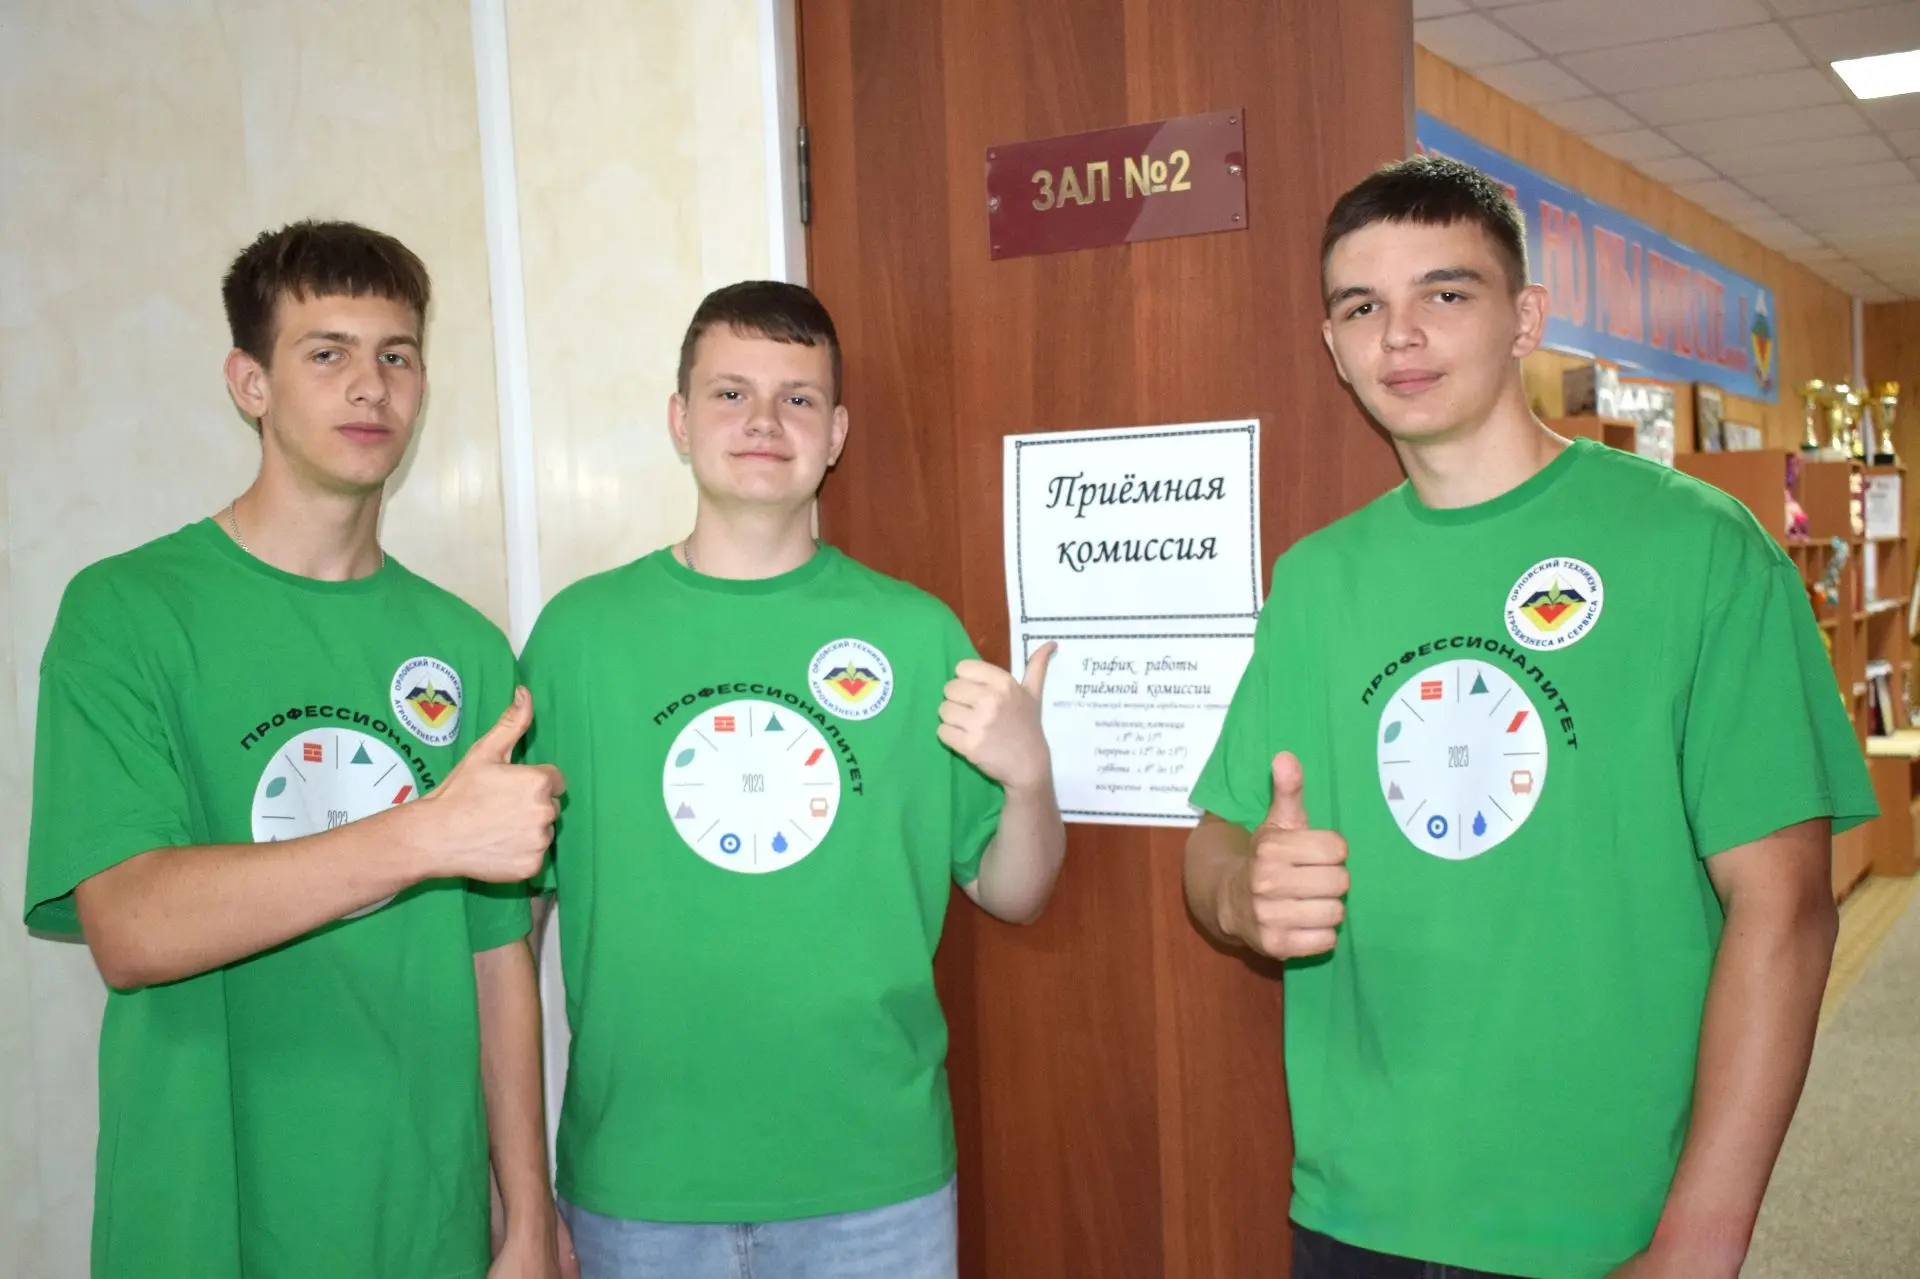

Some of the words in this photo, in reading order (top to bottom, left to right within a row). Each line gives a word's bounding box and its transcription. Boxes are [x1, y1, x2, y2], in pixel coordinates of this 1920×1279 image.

[1031, 160, 1111, 211] ЗАЛ
[1124, 149, 1192, 199] №2
[1540, 200, 1588, 327] НО
[1046, 471, 1226, 519] Приёмная
[1057, 535, 1218, 573] комиссия
[1510, 559, 1560, 602] ОРЛОВСКИЙ
[1567, 600, 1599, 639] СЕРВИСА
[1082, 656, 1138, 676] График
[1144, 655, 1199, 675] работы
[1075, 681, 1139, 698] приёмной
[1147, 682, 1212, 697] комиссии
[1361, 635, 1578, 750] ПРОФЕССИОНАЛИТЕТ
[240, 704, 436, 791] ПРОФЕССИОНАЛИ
[653, 682, 863, 796] ПРОФЕССИОНАЛИТЕТ
[1448, 745, 1469, 768] 2023
[742, 773, 765, 793] 2023
